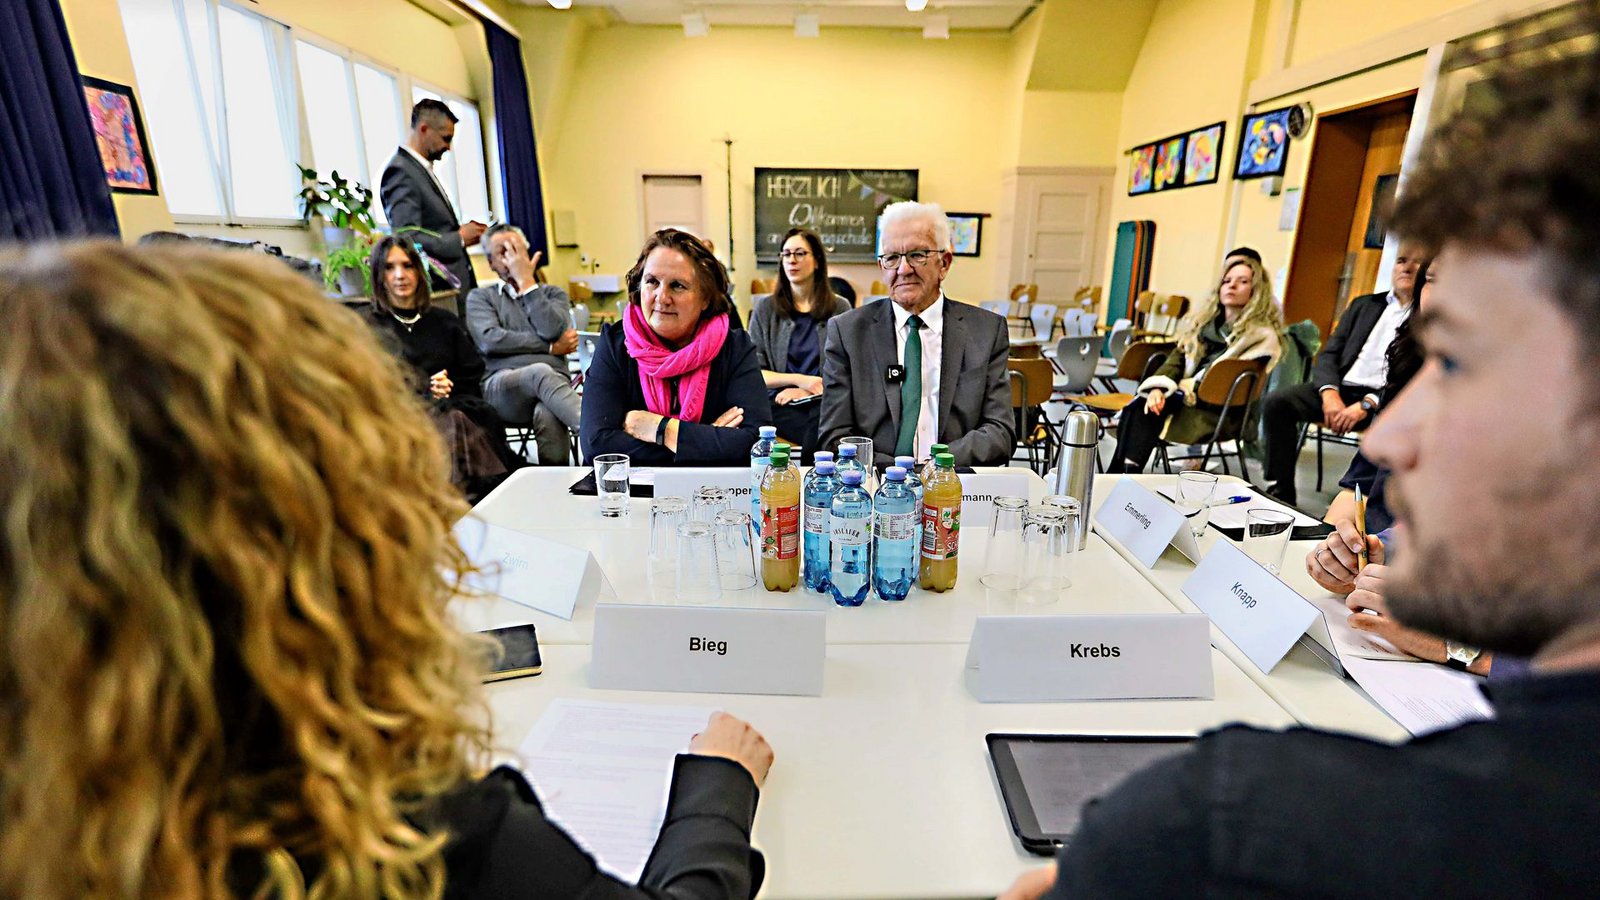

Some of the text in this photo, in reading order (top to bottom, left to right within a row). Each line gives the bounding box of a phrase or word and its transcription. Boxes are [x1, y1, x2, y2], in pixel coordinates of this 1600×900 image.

[962, 494, 992, 502] mann
[1124, 502, 1151, 530] Emmerling
[502, 552, 529, 570] Zwirn
[1230, 581, 1257, 609] Knapp
[689, 636, 728, 656] Bieg
[1070, 643, 1121, 658] Krebs
